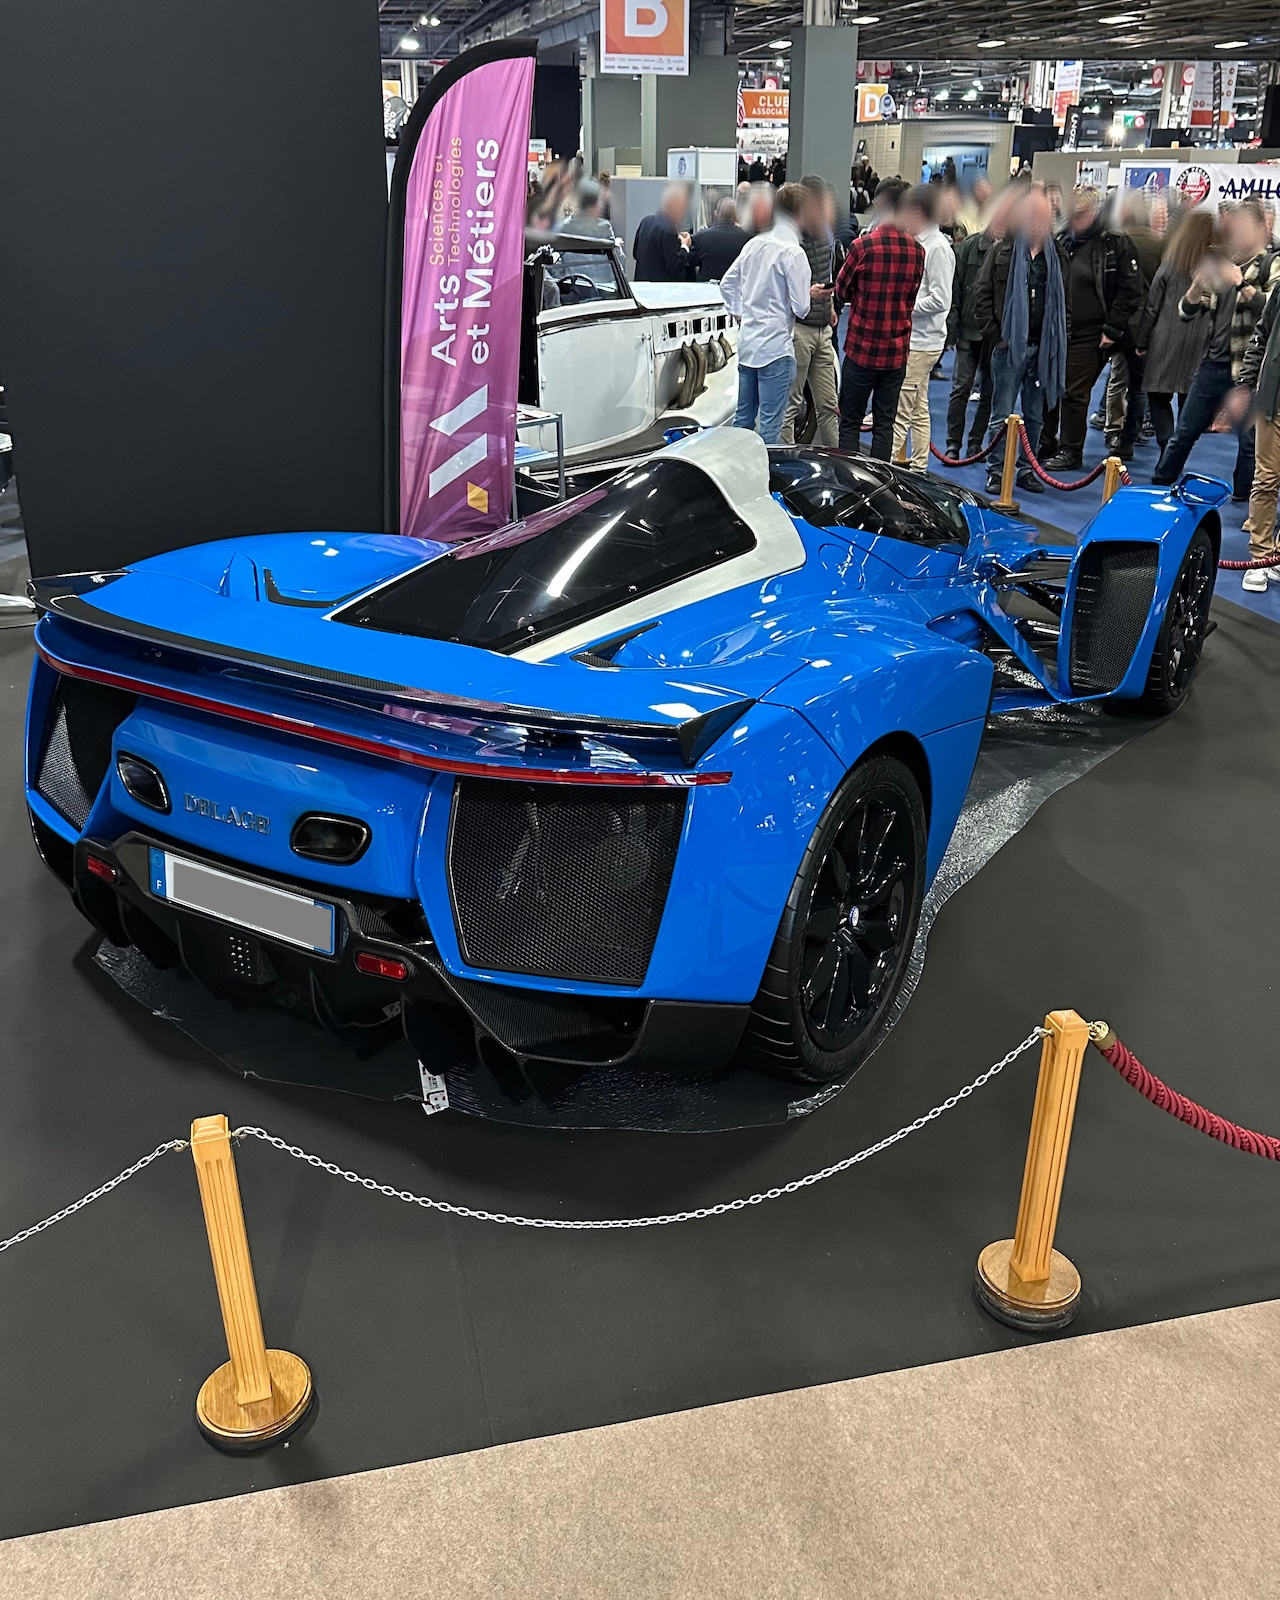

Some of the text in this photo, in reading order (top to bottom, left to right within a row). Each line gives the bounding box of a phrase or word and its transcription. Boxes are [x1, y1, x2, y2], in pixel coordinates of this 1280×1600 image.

[624, 0, 668, 37] B
[864, 93, 881, 118] D
[429, 153, 444, 266] Sciences et
[447, 137, 464, 266] Technologies
[462, 138, 500, 365] et Métiers
[431, 275, 461, 367] Arts
[184, 792, 271, 835] DELAGE
[156, 879, 162, 890] F
